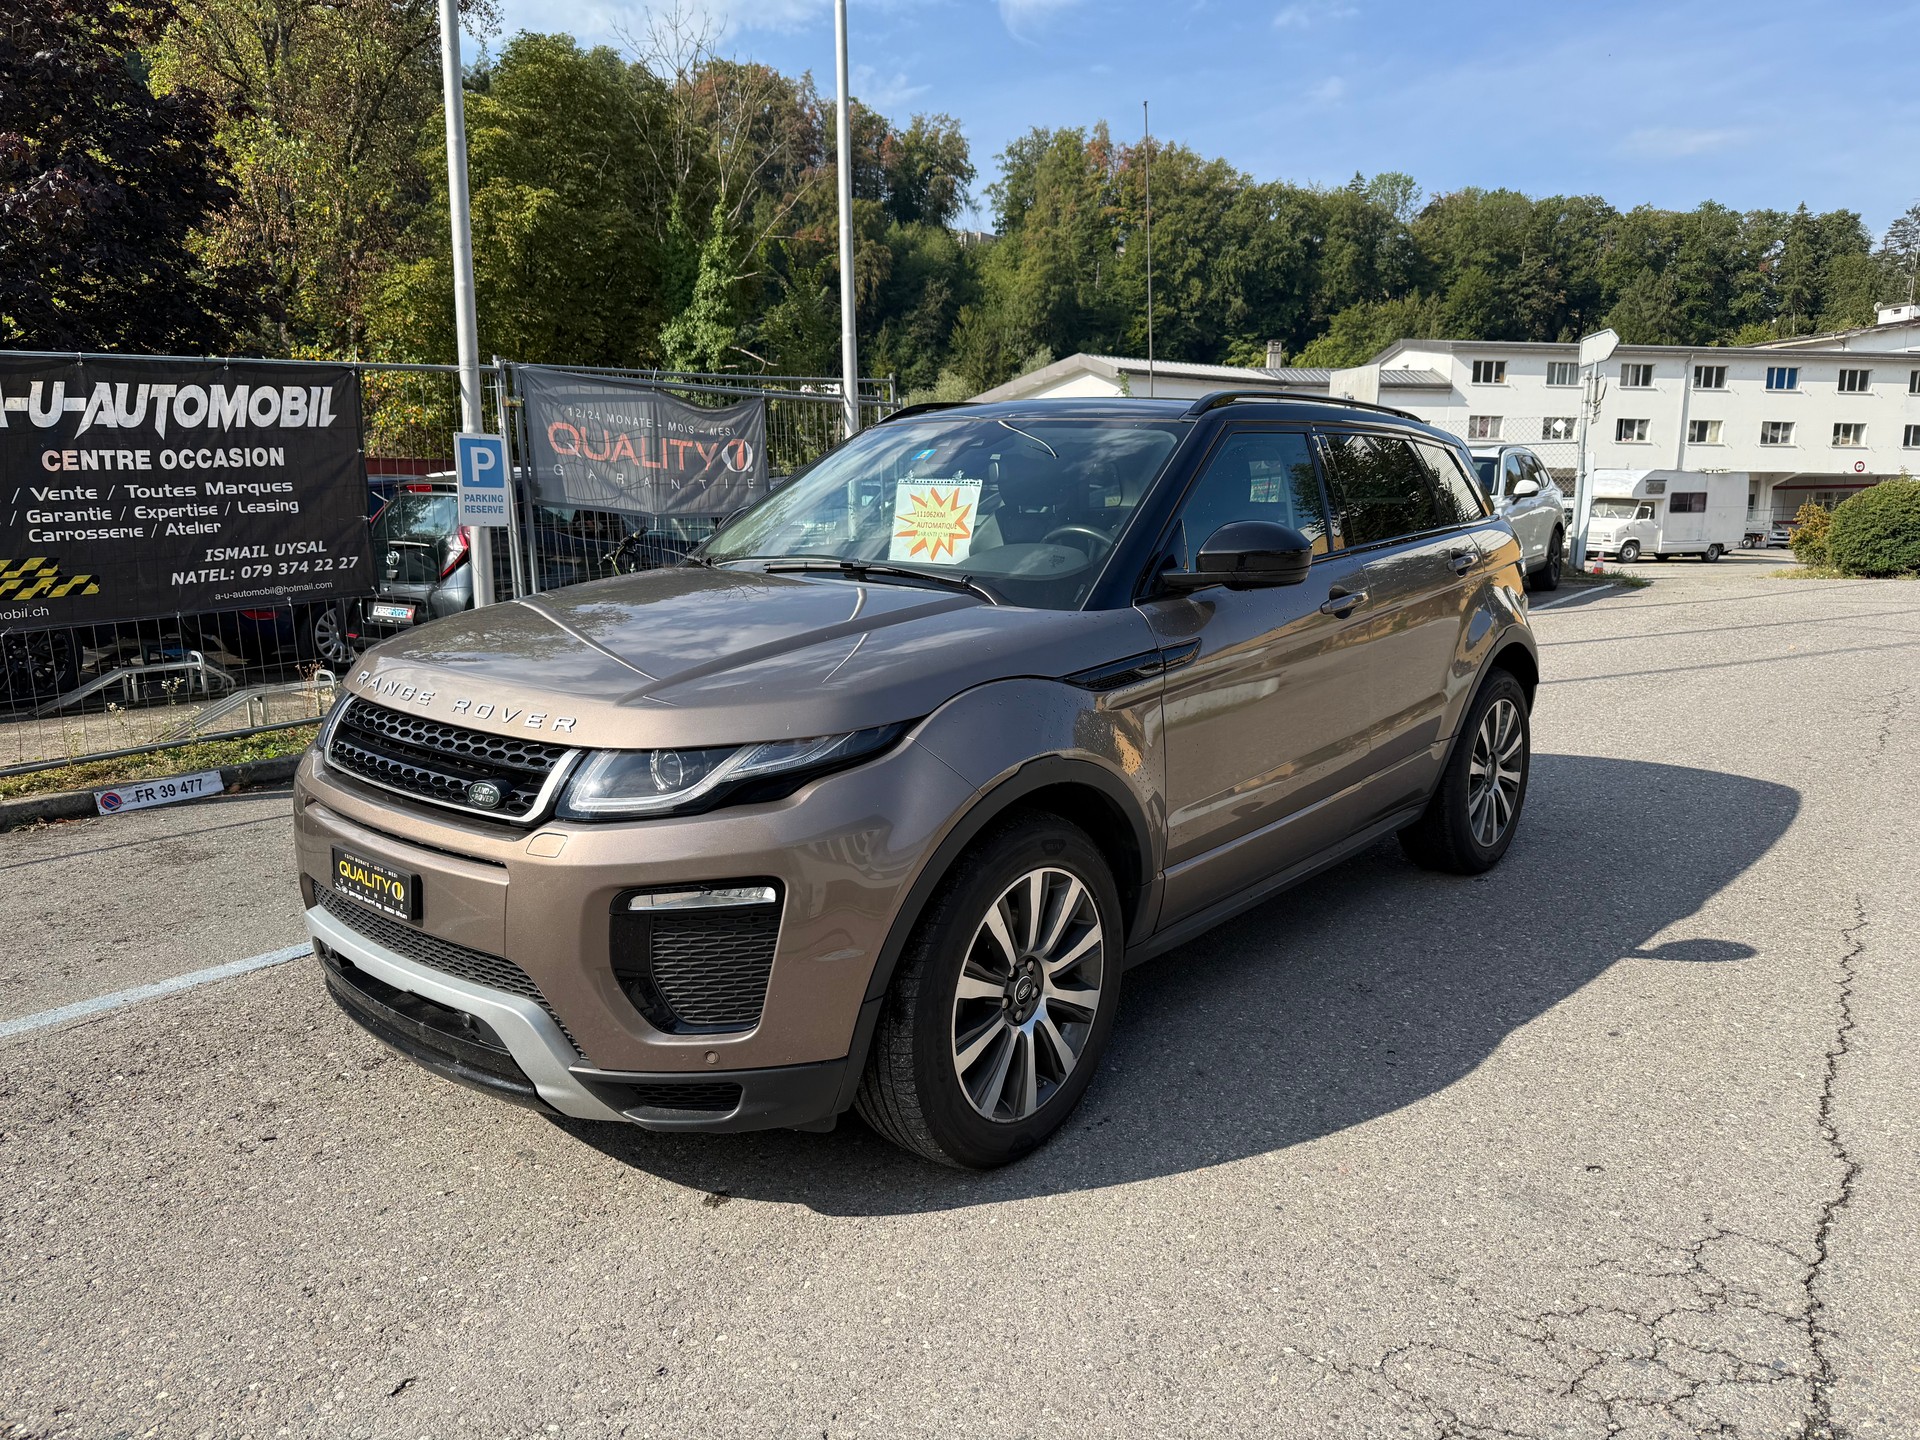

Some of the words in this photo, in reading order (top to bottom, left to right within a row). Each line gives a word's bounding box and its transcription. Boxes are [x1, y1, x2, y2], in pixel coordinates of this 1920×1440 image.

[567, 407, 600, 421] 12/24
[606, 413, 653, 428] MONATE
[667, 422, 695, 435] MOIS
[709, 427, 736, 436] MESI
[548, 421, 719, 472] QUALITY
[41, 448, 153, 472] CENTRE
[158, 447, 286, 470] OCCASION
[471, 446, 496, 482] P
[553, 463, 755, 490] GARANTIE
[29, 486, 98, 501] Vente
[124, 483, 197, 499] Toutes
[205, 481, 294, 497] Marques
[464, 493, 504, 504] PARKING
[26, 506, 113, 524] Garantie
[133, 503, 219, 522] Expertise
[237, 500, 300, 515] Leasing
[464, 504, 504, 515] RESERVE
[28, 527, 144, 543] Carrosserie
[165, 521, 222, 537] Atelier
[917, 522, 957, 530] AUTOMATIQUE
[204, 545, 270, 563] ISMAIL
[275, 540, 328, 558] UYSAL
[171, 569, 236, 586] NATEL:
[240, 564, 273, 580] 079
[277, 561, 309, 577] 374
[313, 559, 336, 573] 22
[338, 556, 360, 570] 27
[214, 579, 333, 600] a-u-automobil@hotmail.com
[355, 669, 436, 706] RANGE
[451, 699, 578, 733] ROVER
[135, 788, 156, 802] FR
[159, 784, 175, 798] 39
[180, 778, 202, 793] 477
[473, 785, 490, 795] LAND
[473, 793, 495, 804] ROVER
[339, 860, 392, 894] QUALITY
